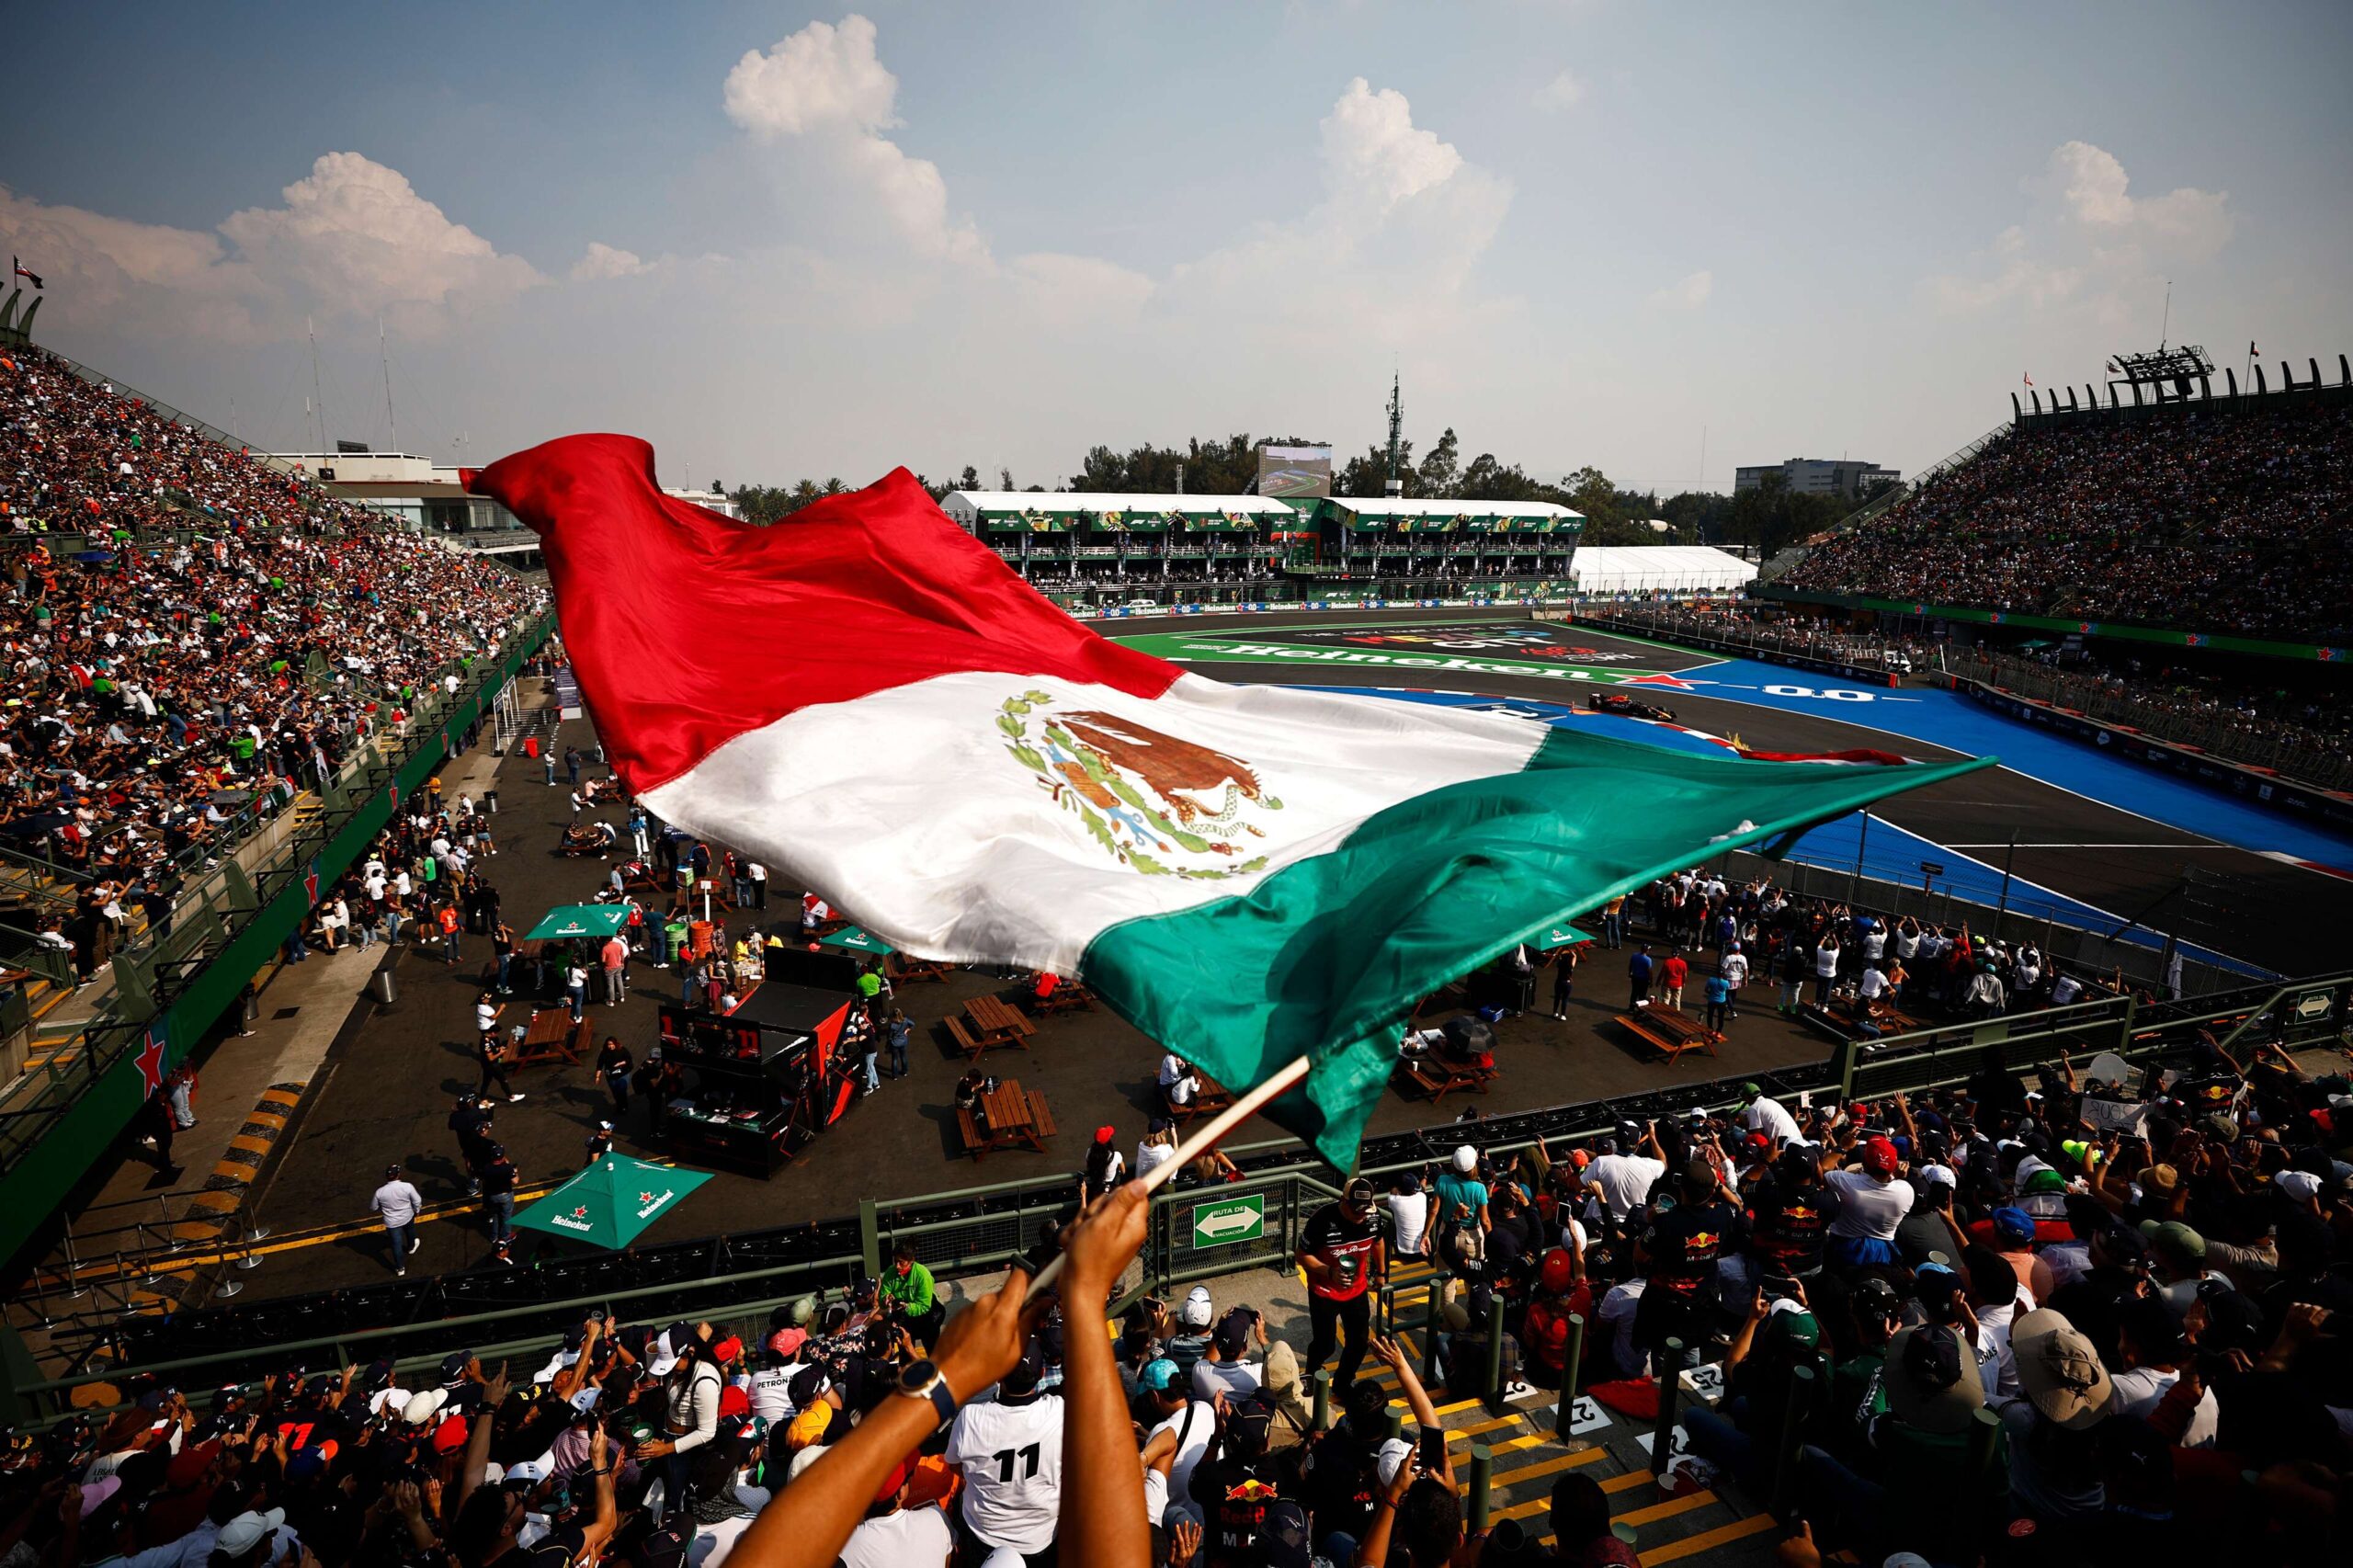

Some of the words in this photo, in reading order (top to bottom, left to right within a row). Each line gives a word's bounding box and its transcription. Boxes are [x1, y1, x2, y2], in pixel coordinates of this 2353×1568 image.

[1065, 610, 1097, 619] eineken
[1135, 607, 1168, 615] Heineken
[1204, 604, 1236, 612] Heineken
[1342, 630, 1552, 644] MEXICO
[1432, 636, 1557, 649] CITY
[1216, 644, 1595, 679] Heineken
[1762, 685, 1877, 702] 0.0
[637, 1189, 675, 1220] Heineken
[1213, 1208, 1233, 1216] RUTA
[551, 1214, 594, 1232] Heineken
[992, 1442, 1040, 1483] 11
